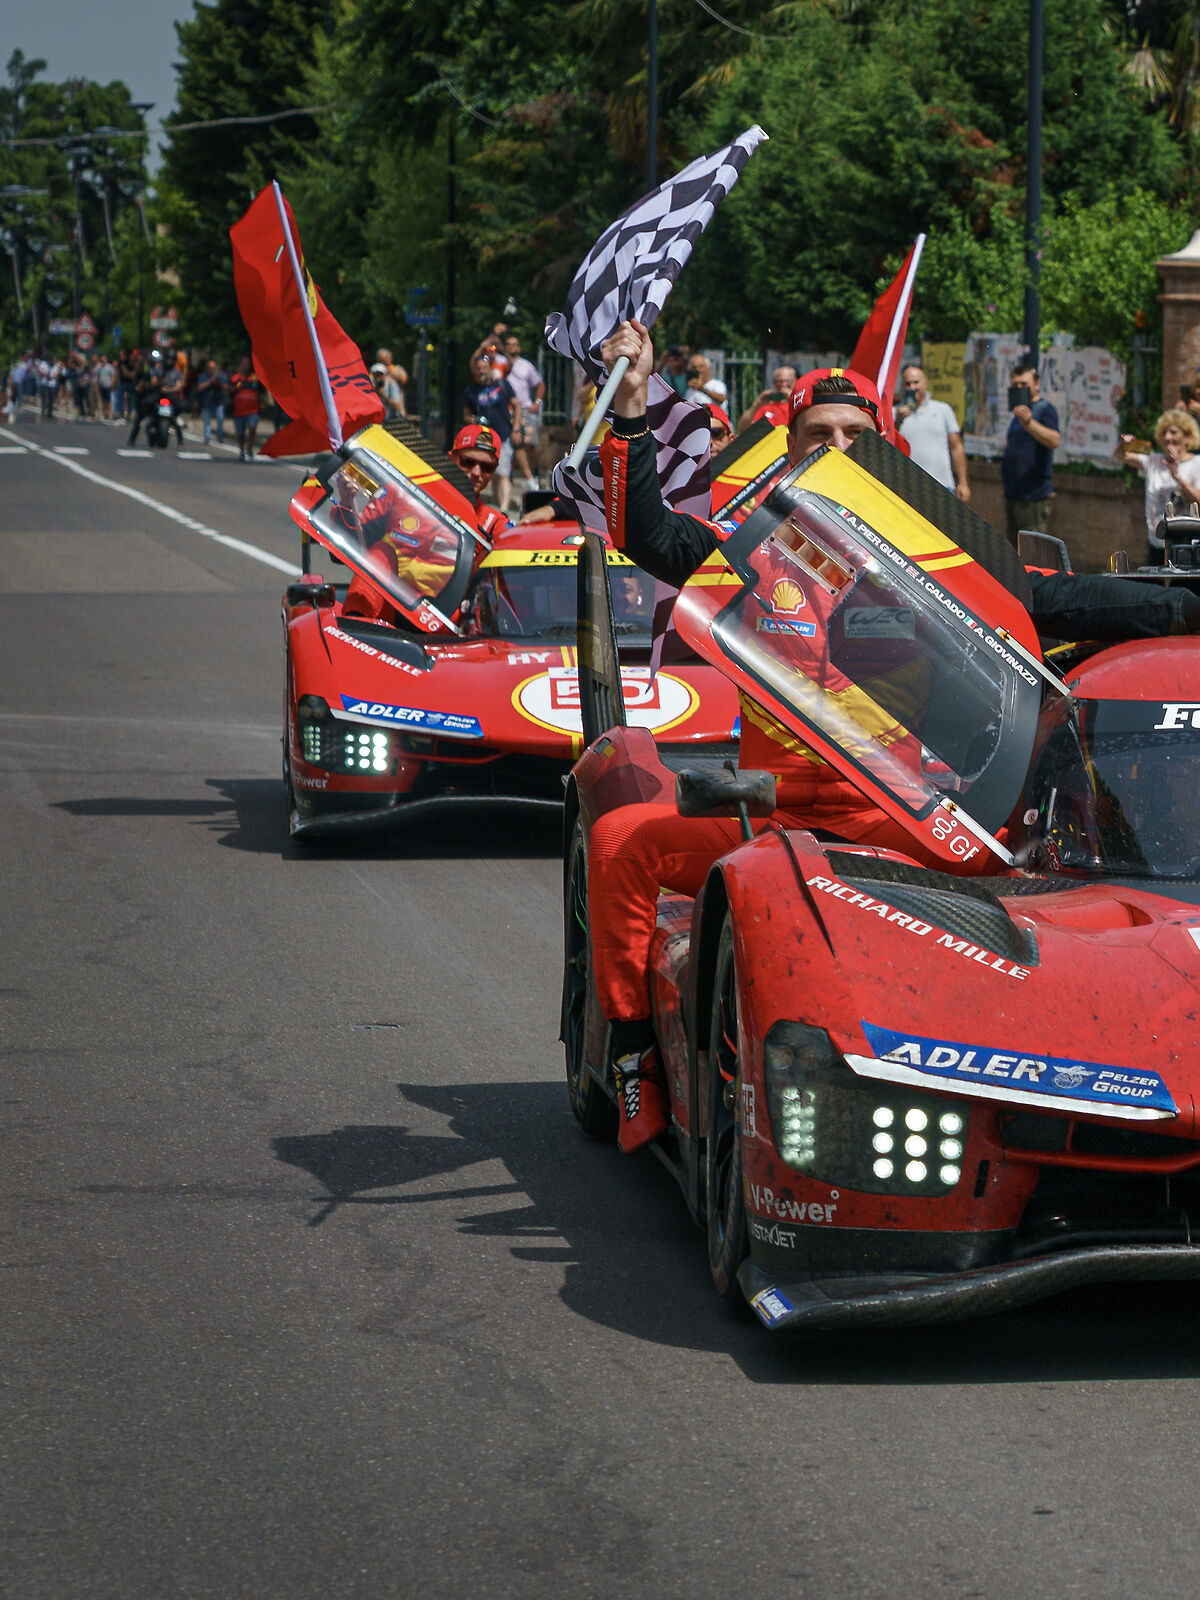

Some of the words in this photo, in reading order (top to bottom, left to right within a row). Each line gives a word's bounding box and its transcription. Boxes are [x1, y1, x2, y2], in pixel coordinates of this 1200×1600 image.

[857, 524, 882, 546] PIER
[879, 543, 907, 568] GUIDI
[925, 582, 965, 619] CALADO
[984, 636, 1038, 687] GIOVINAZZI
[323, 626, 378, 656] RICHARD
[378, 654, 422, 677] MILLE
[507, 652, 550, 665] HY
[347, 703, 425, 722] ADLER
[806, 875, 933, 937] RICHARD
[936, 933, 1031, 980] MILLE
[880, 1042, 1048, 1083] ADLER
[1098, 1071, 1159, 1087] PELZER
[1092, 1082, 1153, 1098] GROUP
[750, 1183, 837, 1223] V-Power
